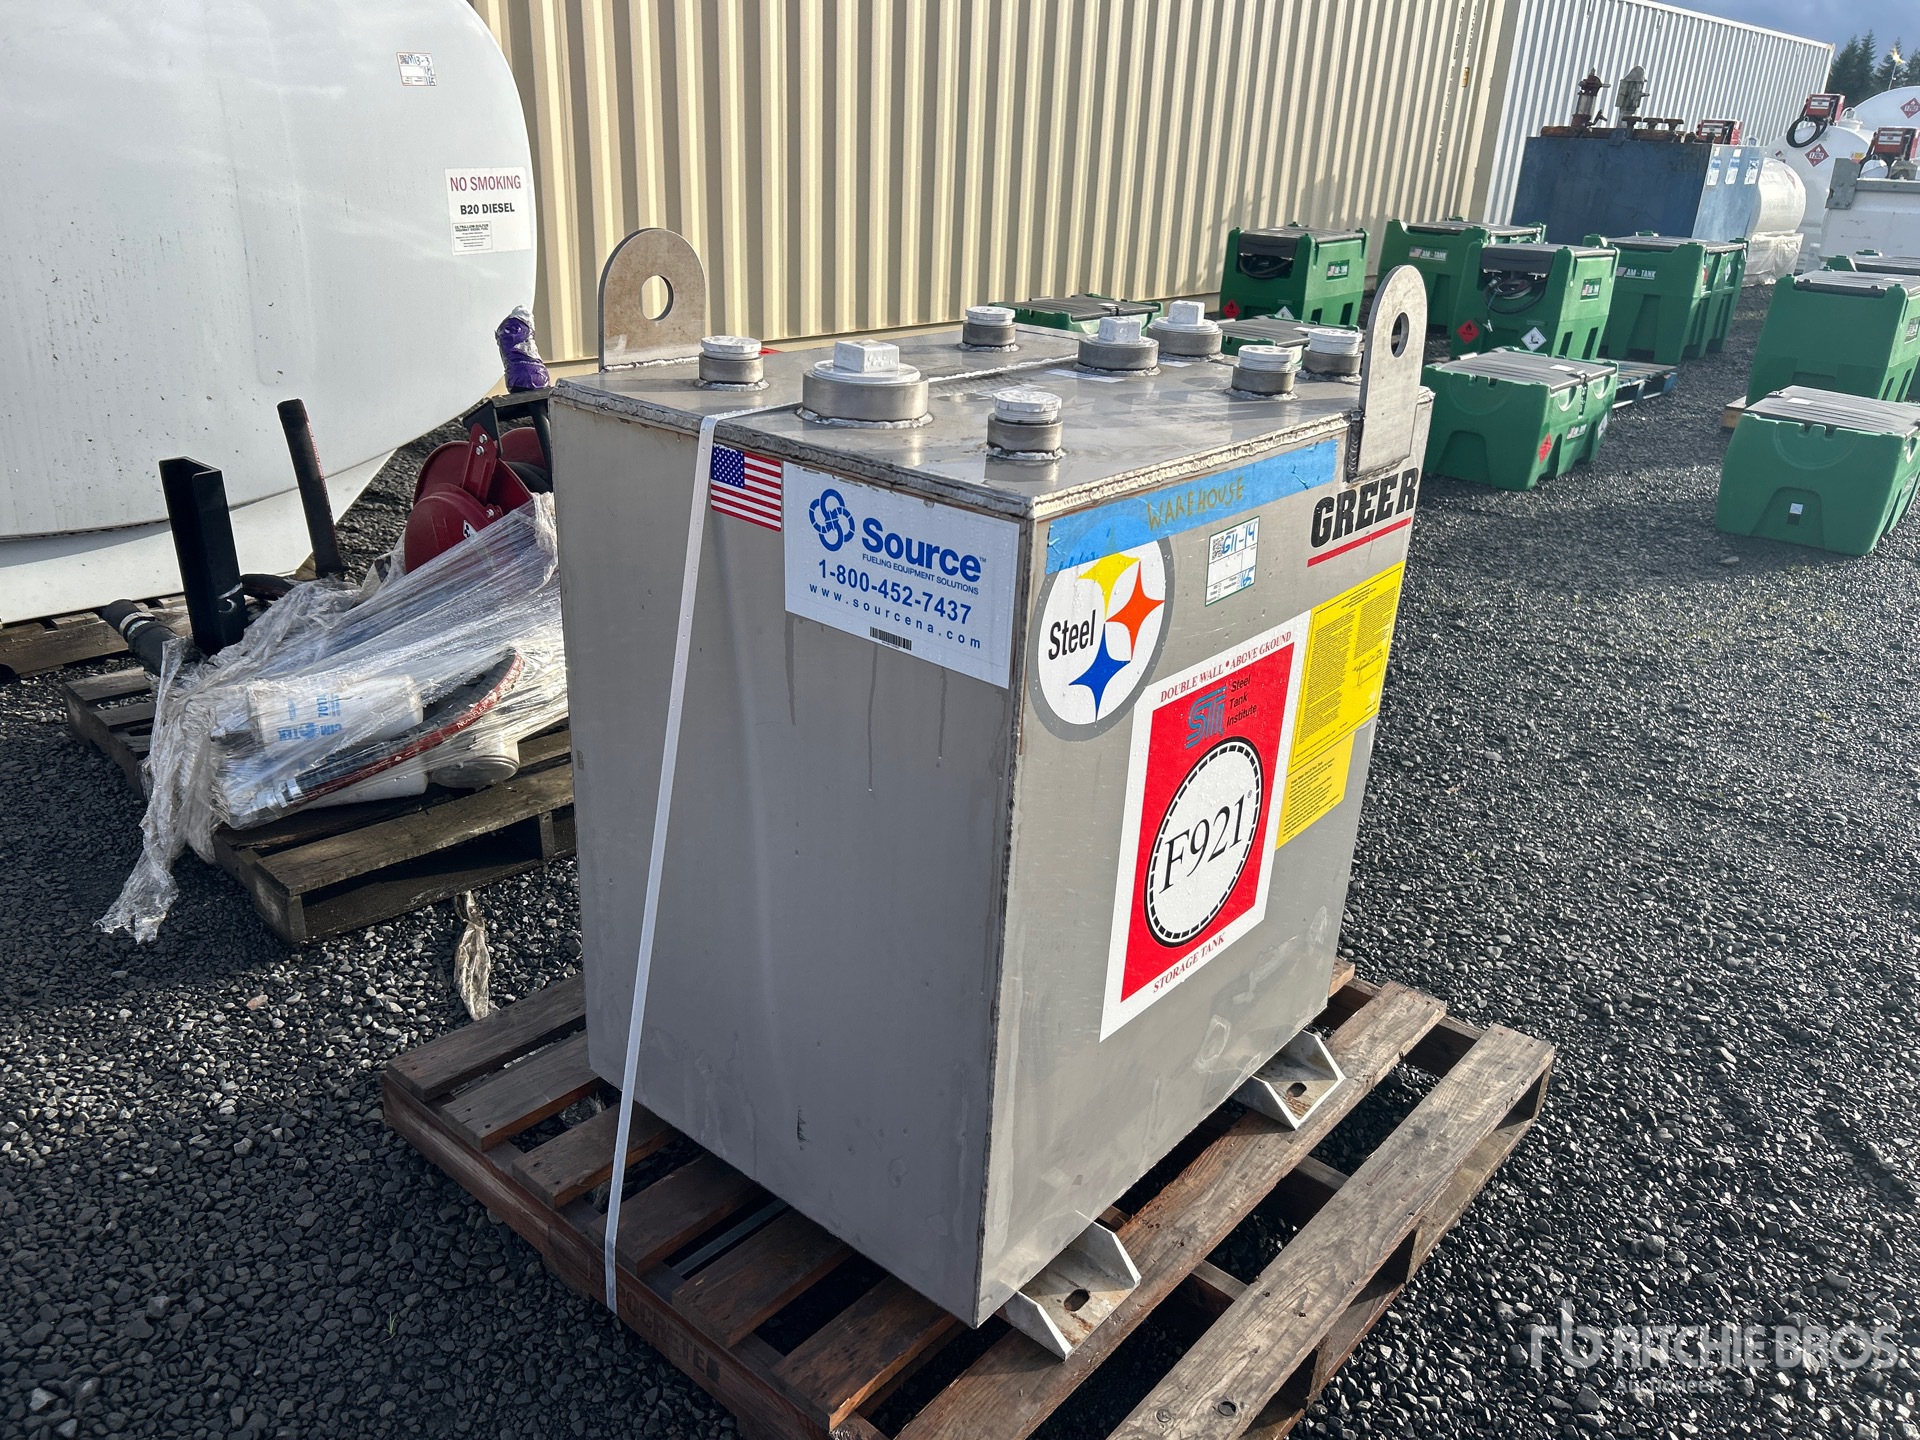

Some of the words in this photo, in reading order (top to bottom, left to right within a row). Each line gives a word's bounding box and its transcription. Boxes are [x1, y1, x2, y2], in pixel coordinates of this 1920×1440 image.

[450, 177, 467, 191] NO
[470, 175, 521, 191] SMOKING
[460, 204, 479, 215] B20
[482, 203, 515, 214] DIESEL
[1147, 476, 1245, 531] WAREHOUSE
[1310, 468, 1419, 548] GREER
[862, 517, 981, 582] Source
[862, 553, 892, 568] FUELING
[893, 563, 935, 582] EQUIPMENT
[936, 576, 979, 595] SOLUTIONS
[819, 559, 972, 625] 1-800-452-7437
[1048, 609, 1096, 660] Steel
[1160, 676, 1198, 702] DOUBLE
[1200, 664, 1223, 683] WALL
[1229, 647, 1258, 670] ABOVE
[1259, 631, 1291, 655] GROUND
[1231, 673, 1251, 692] Steel
[1226, 704, 1257, 727] Institute
[1229, 692, 1248, 710] Tank
[1159, 794, 1245, 894] F921
[1153, 951, 1199, 993] STORAGE
[1200, 932, 1226, 958] TANK
